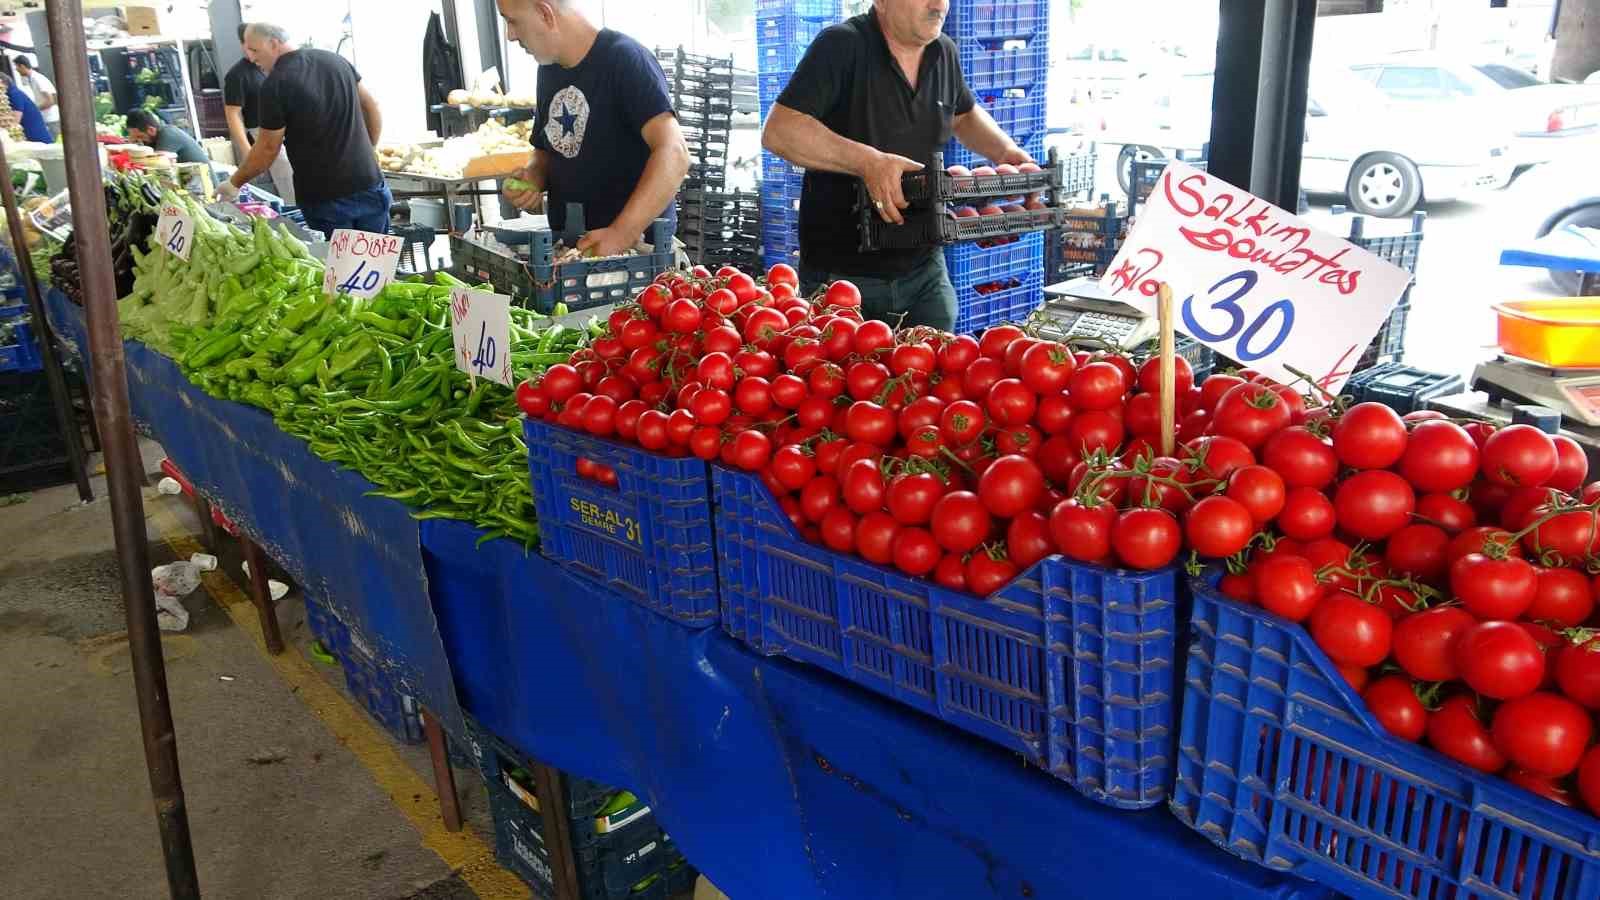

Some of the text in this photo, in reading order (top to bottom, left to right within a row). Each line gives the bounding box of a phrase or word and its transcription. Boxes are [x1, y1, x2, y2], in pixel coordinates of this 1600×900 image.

[336, 260, 380, 294] 40
[1182, 269, 1295, 361] 30
[472, 320, 496, 375] 40
[625, 518, 642, 544] 31
